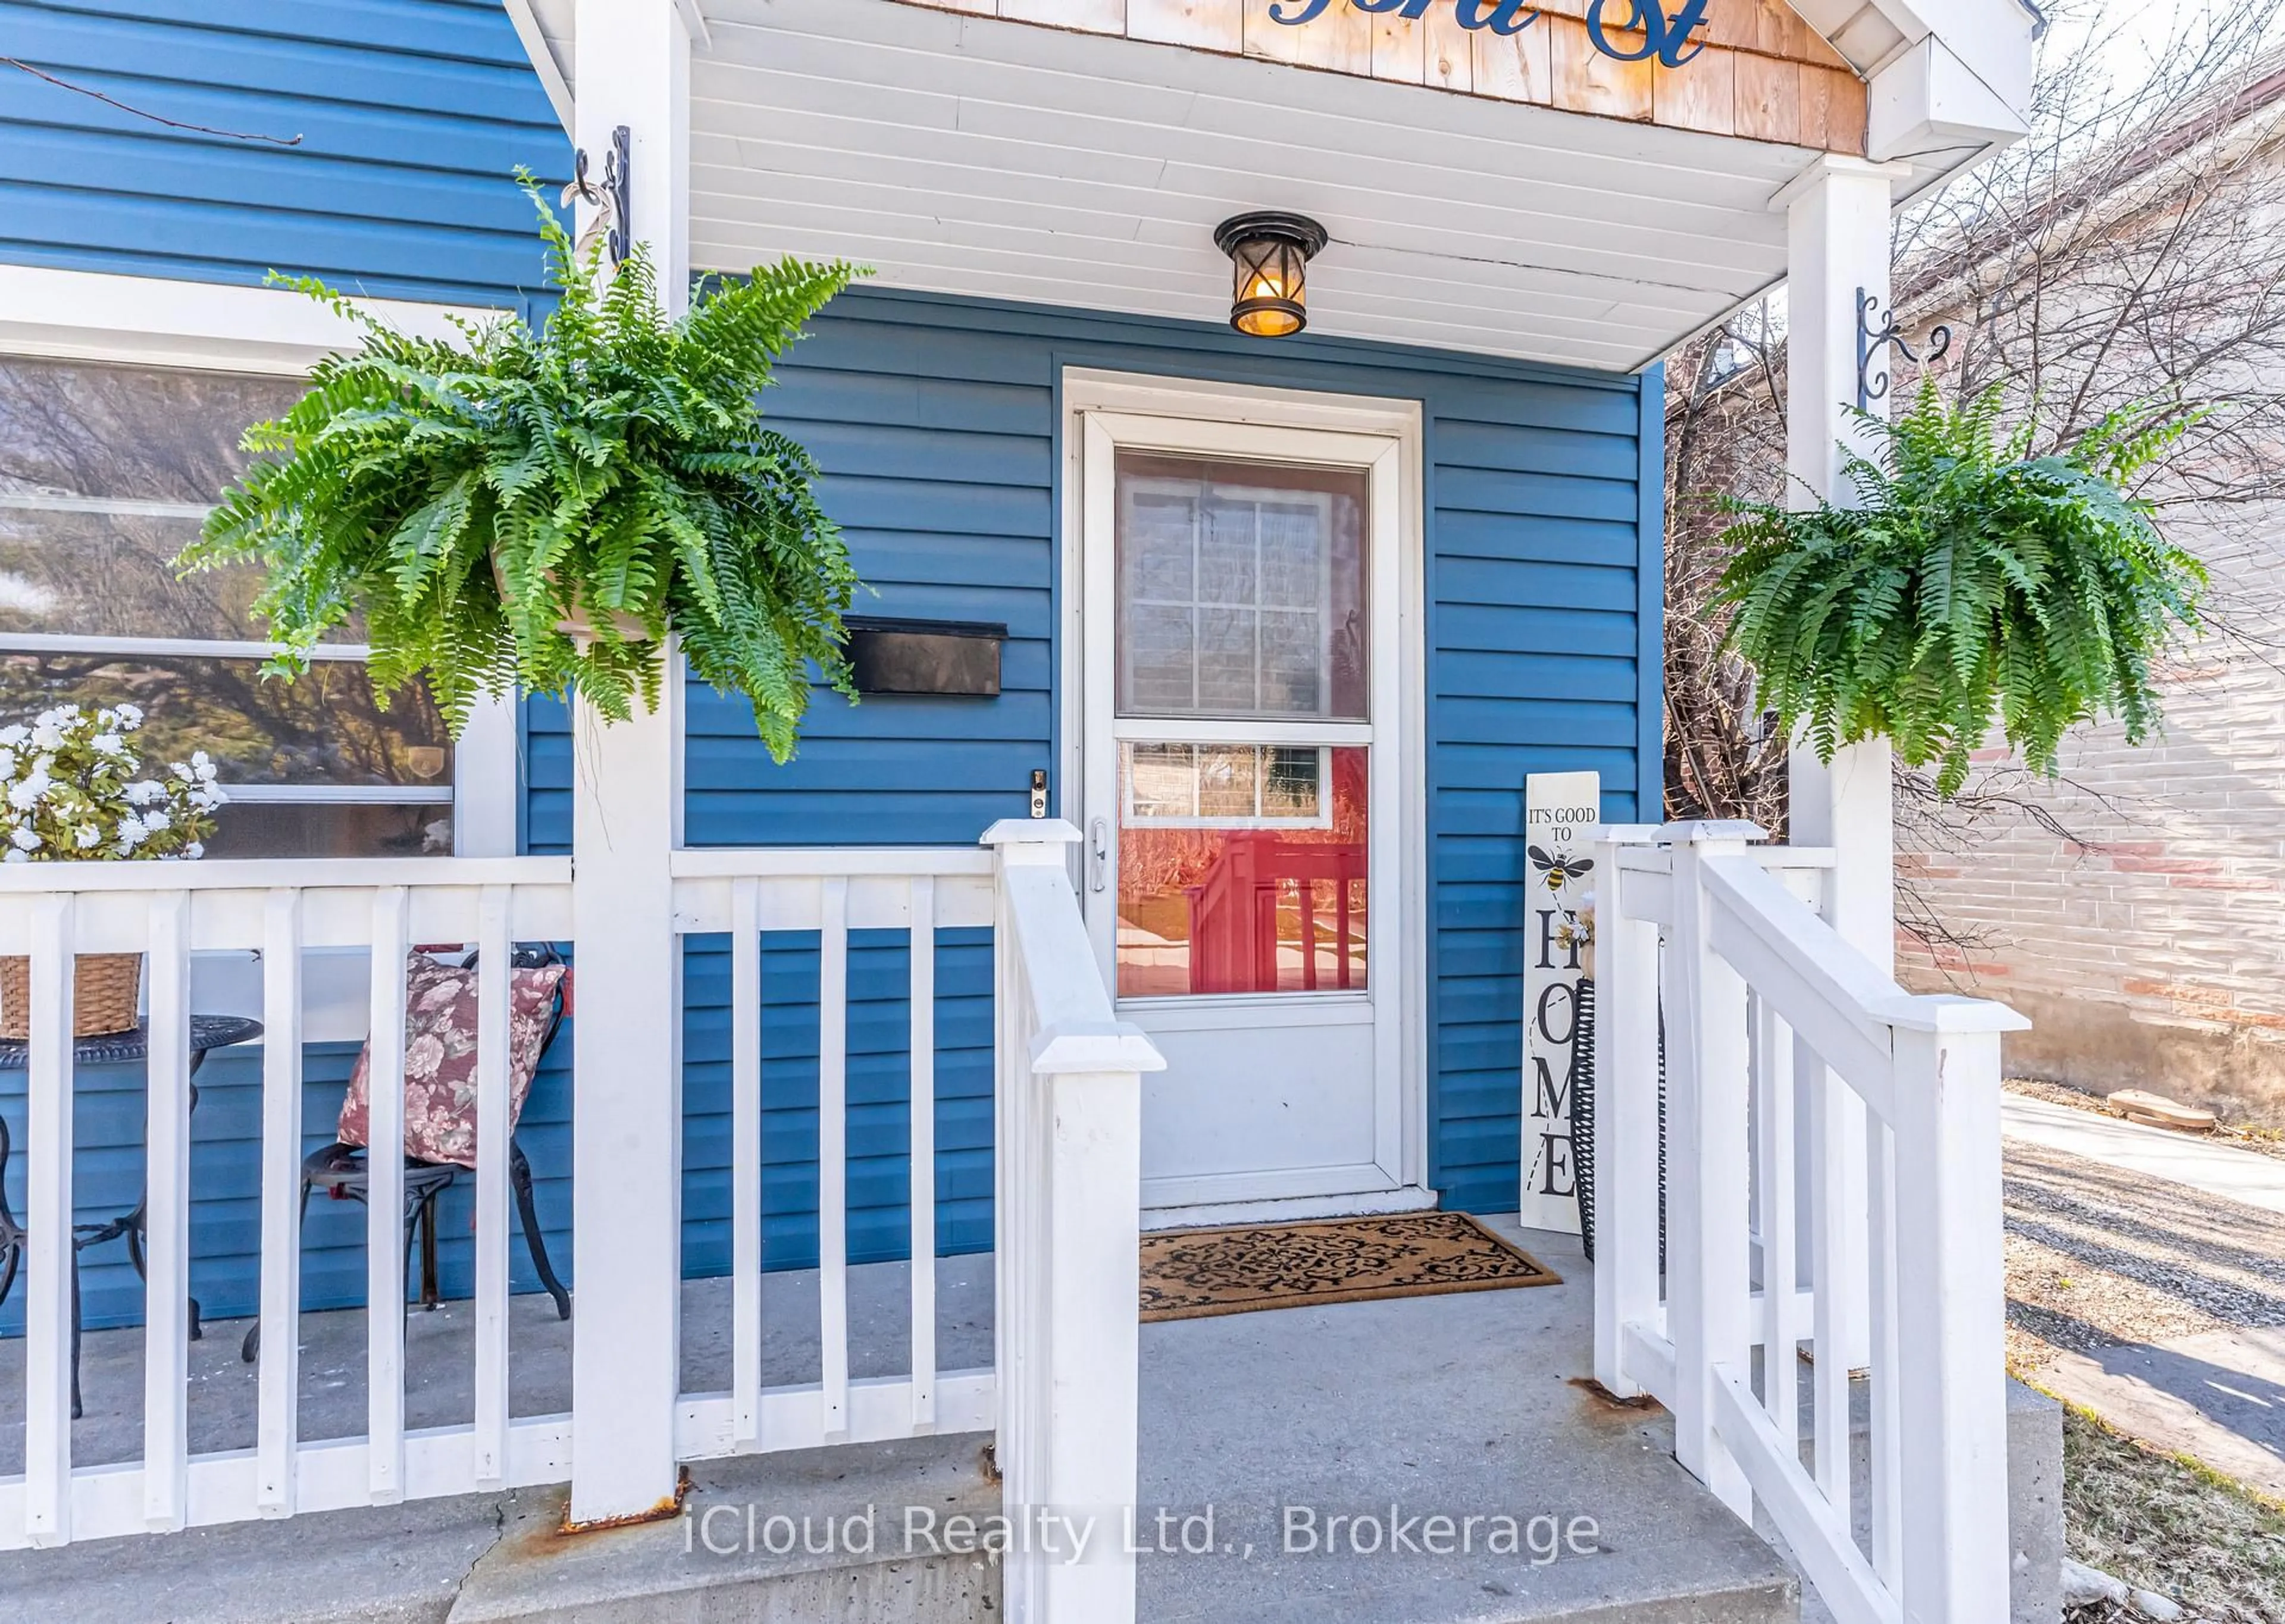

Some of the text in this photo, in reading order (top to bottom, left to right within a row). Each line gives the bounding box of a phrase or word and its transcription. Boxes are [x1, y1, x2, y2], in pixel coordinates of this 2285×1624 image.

[1529, 807, 1595, 824] IT'S GOOD
[1552, 827, 1572, 842] TO
[1530, 910, 1581, 1197] HOME
